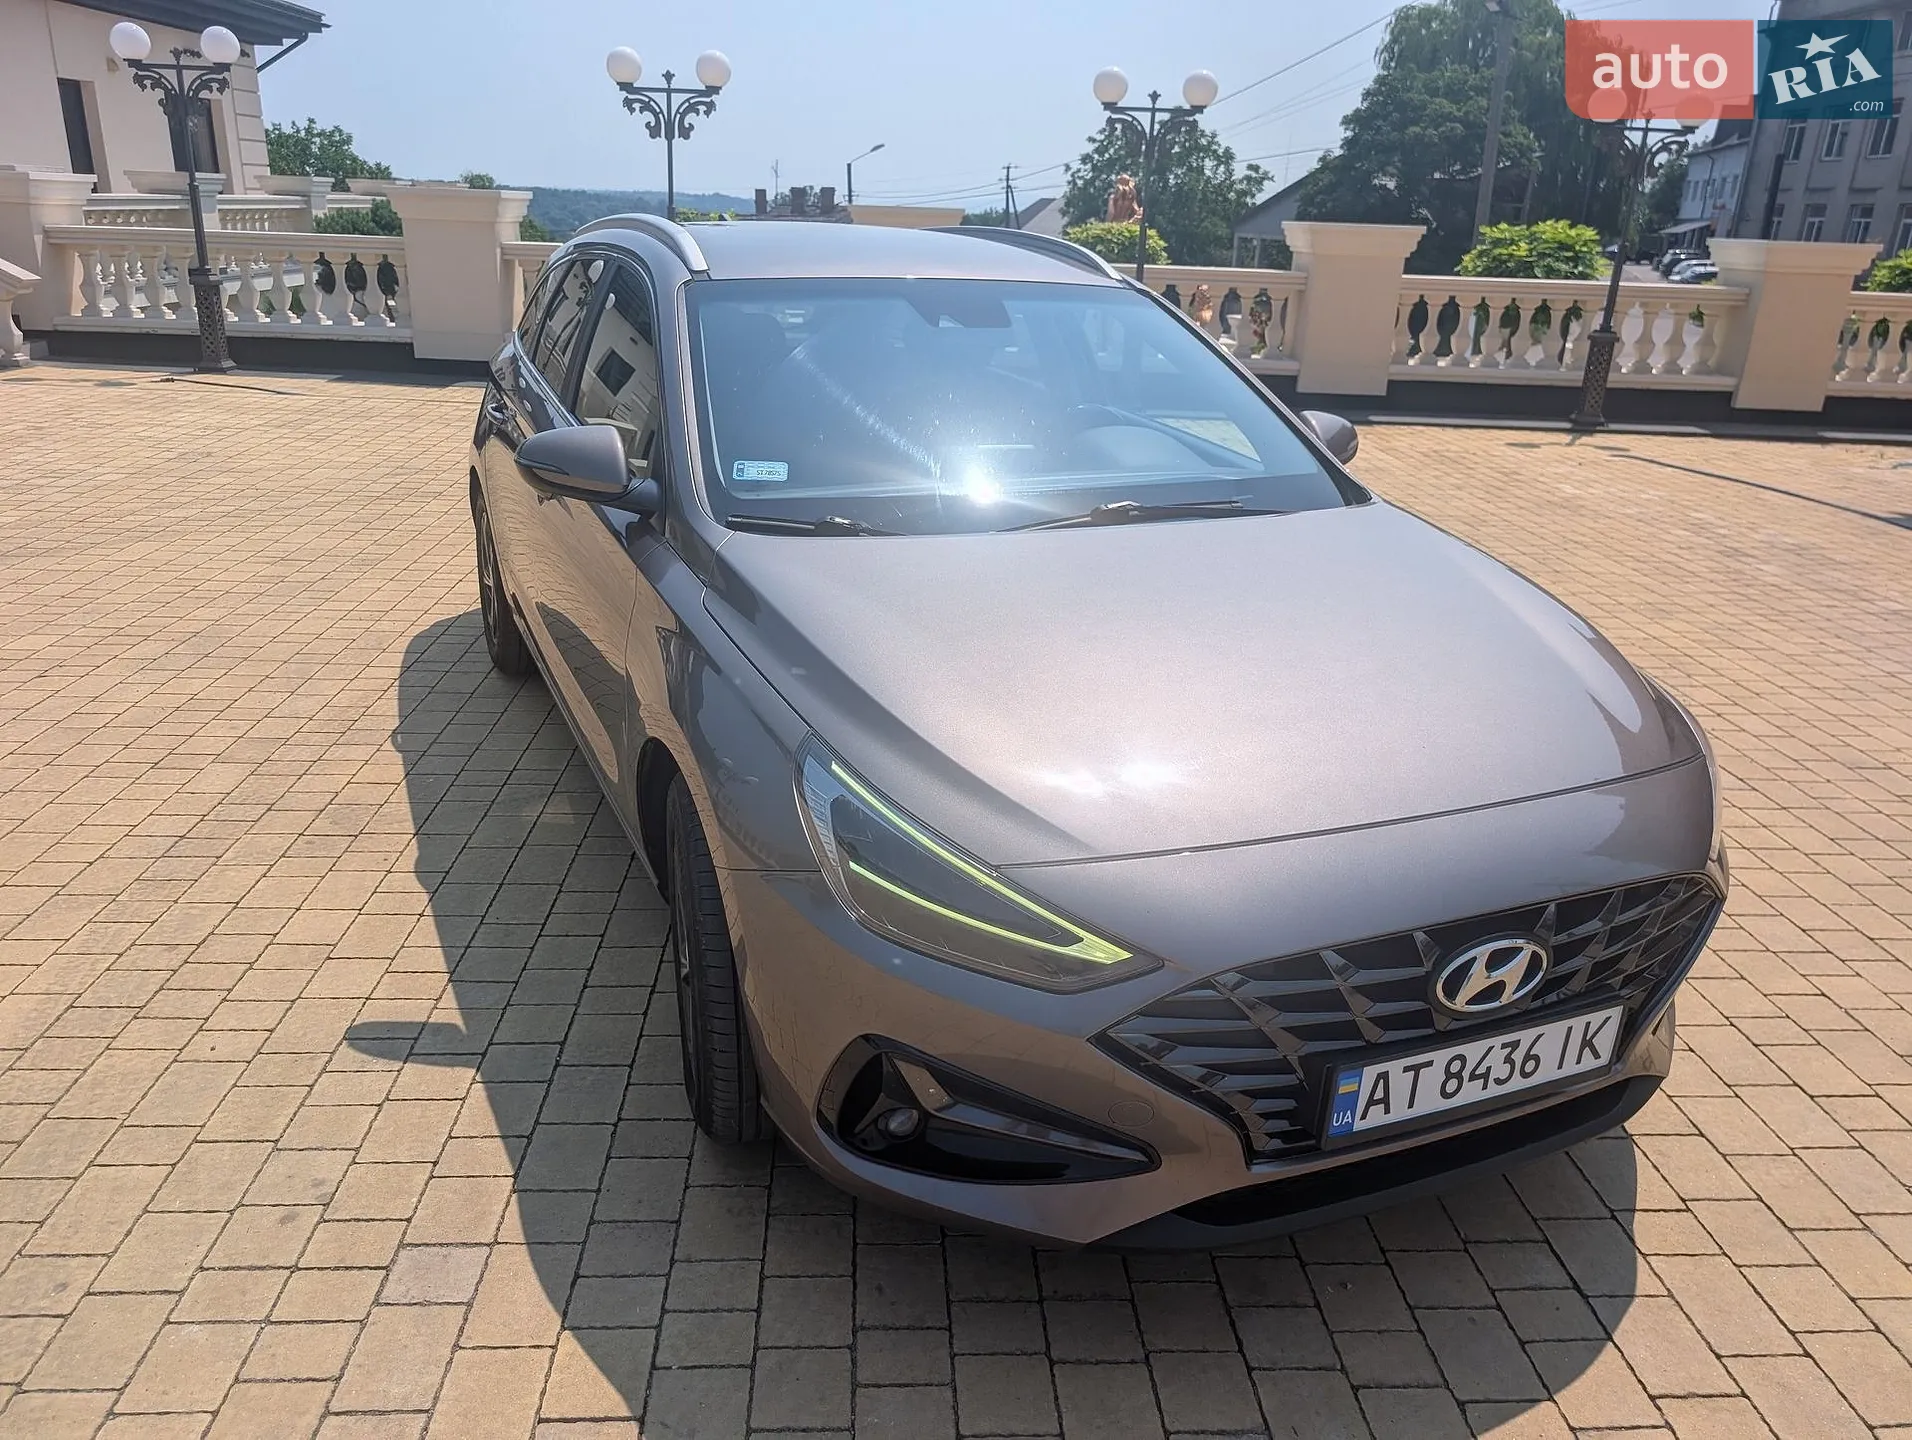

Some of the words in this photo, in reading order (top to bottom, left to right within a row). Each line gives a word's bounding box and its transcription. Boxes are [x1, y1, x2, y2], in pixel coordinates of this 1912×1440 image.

[1359, 1059, 1434, 1122] AT
[1439, 1032, 1545, 1101] 8436
[1556, 1015, 1612, 1071] IK
[1332, 1110, 1352, 1127] UA
